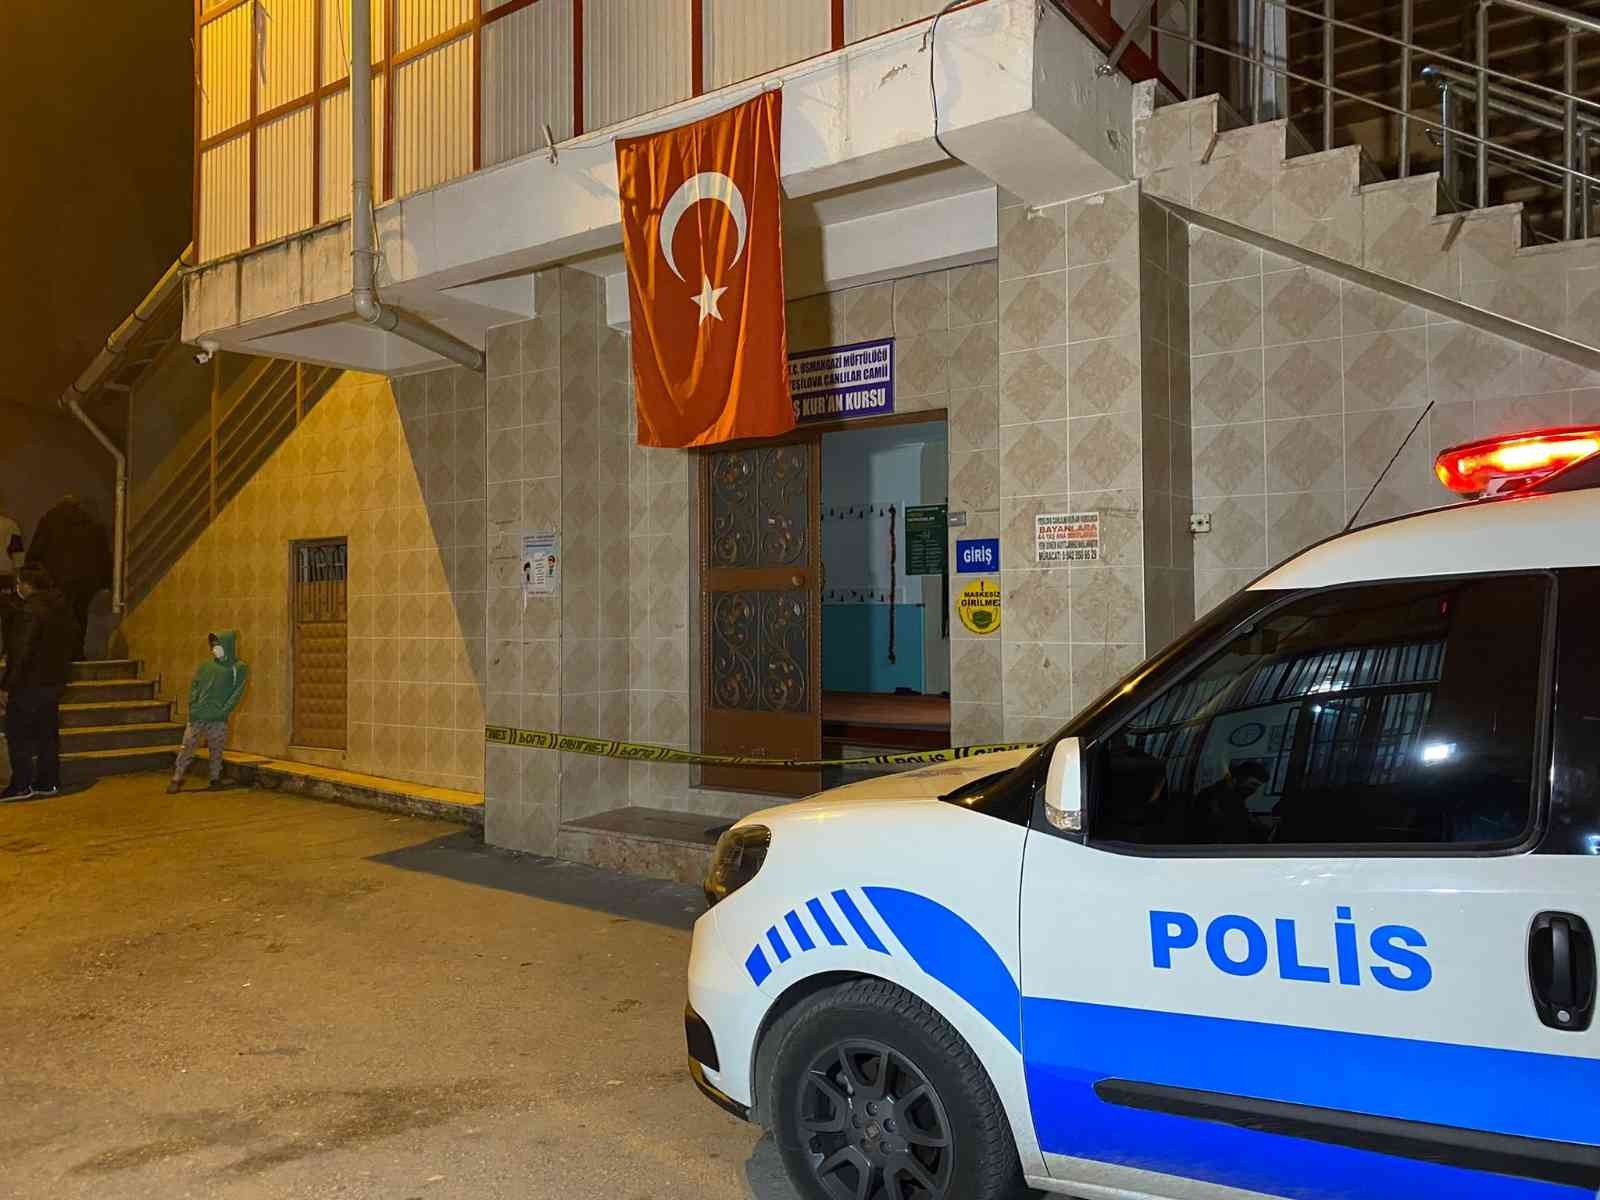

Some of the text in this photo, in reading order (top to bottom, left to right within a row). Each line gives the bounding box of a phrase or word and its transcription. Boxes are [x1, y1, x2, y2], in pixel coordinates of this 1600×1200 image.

[844, 347, 888, 367] MÜFTÜLÜĞÜ
[823, 369, 862, 388] CANLILAR
[864, 364, 888, 381] CAMİİ
[802, 393, 844, 417] KUR'AN
[845, 387, 887, 411] KURSU
[963, 545, 993, 566] GİRİŞ
[961, 599, 1001, 607] GİRİLME
[1149, 906, 1433, 992] POLİS
